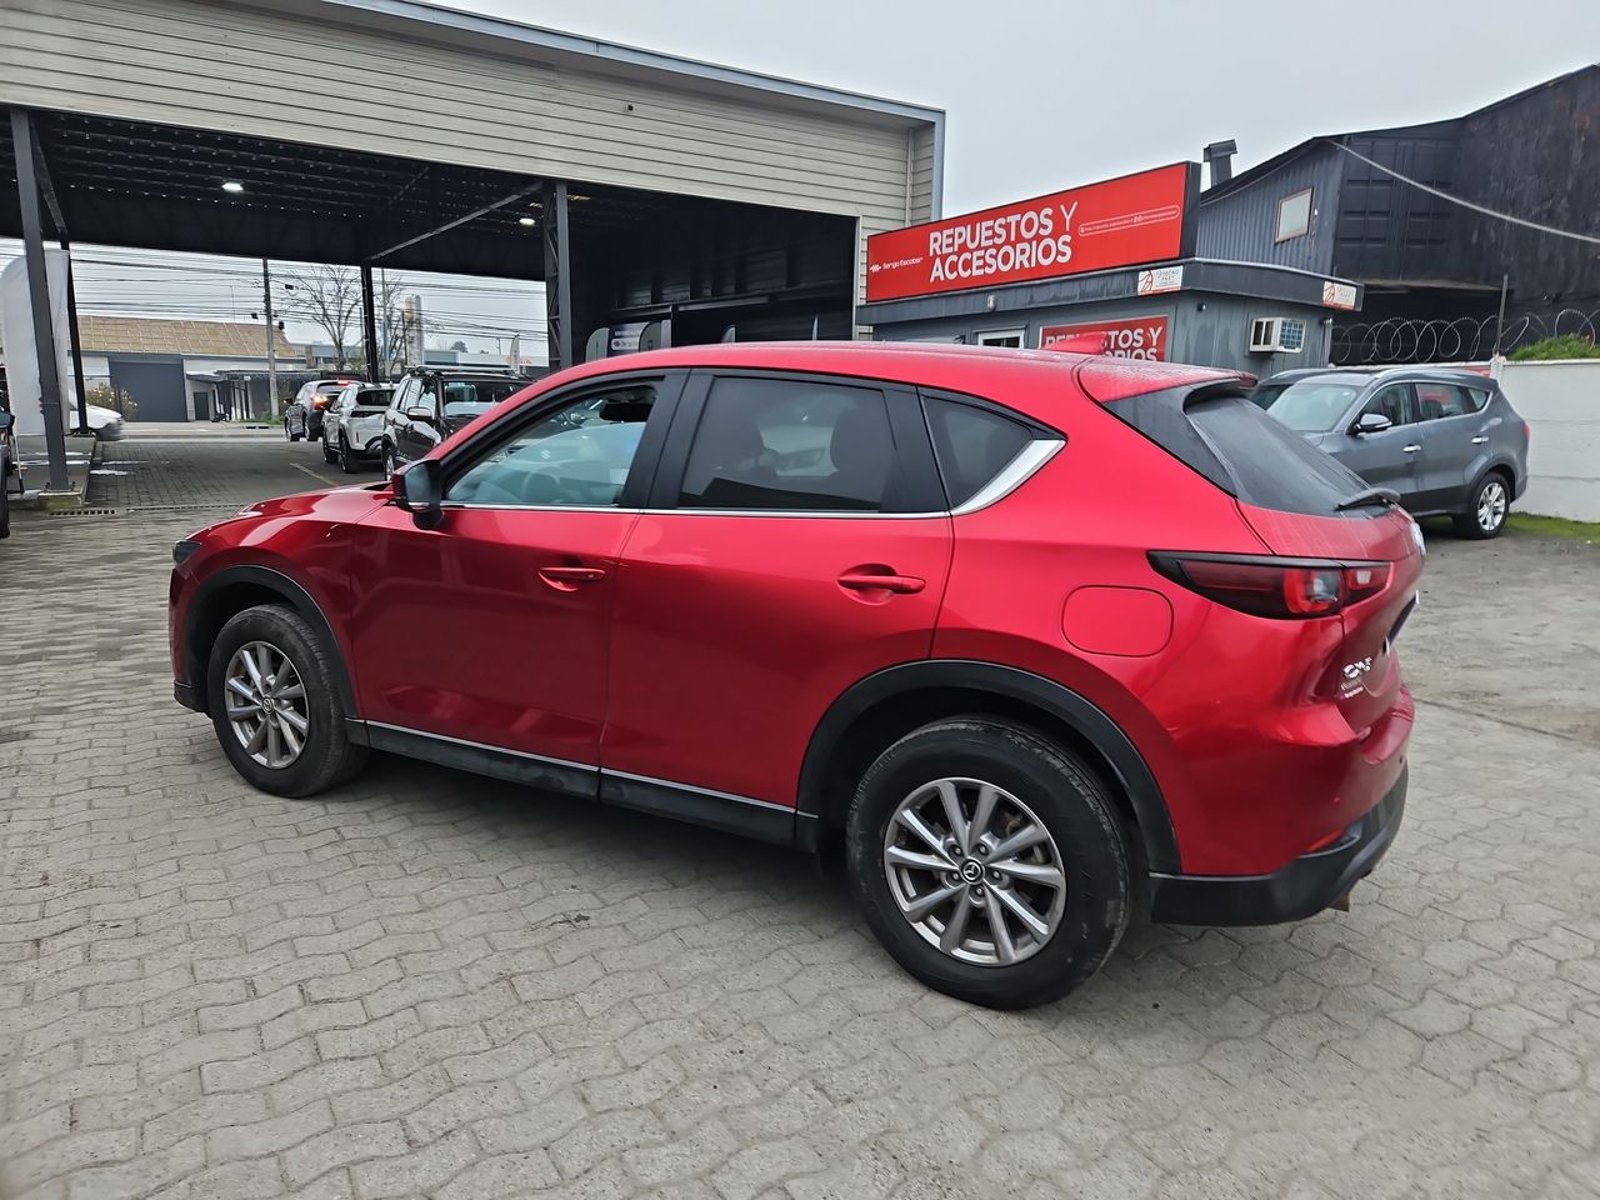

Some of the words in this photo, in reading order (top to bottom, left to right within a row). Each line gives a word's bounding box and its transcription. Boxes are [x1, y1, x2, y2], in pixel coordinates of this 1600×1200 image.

[929, 207, 1054, 257] REPUESTOS
[1060, 201, 1078, 232] Y
[929, 234, 1072, 283] ACCESORIOS
[1045, 328, 1144, 350] RETOS
[1148, 326, 1164, 347] Y
